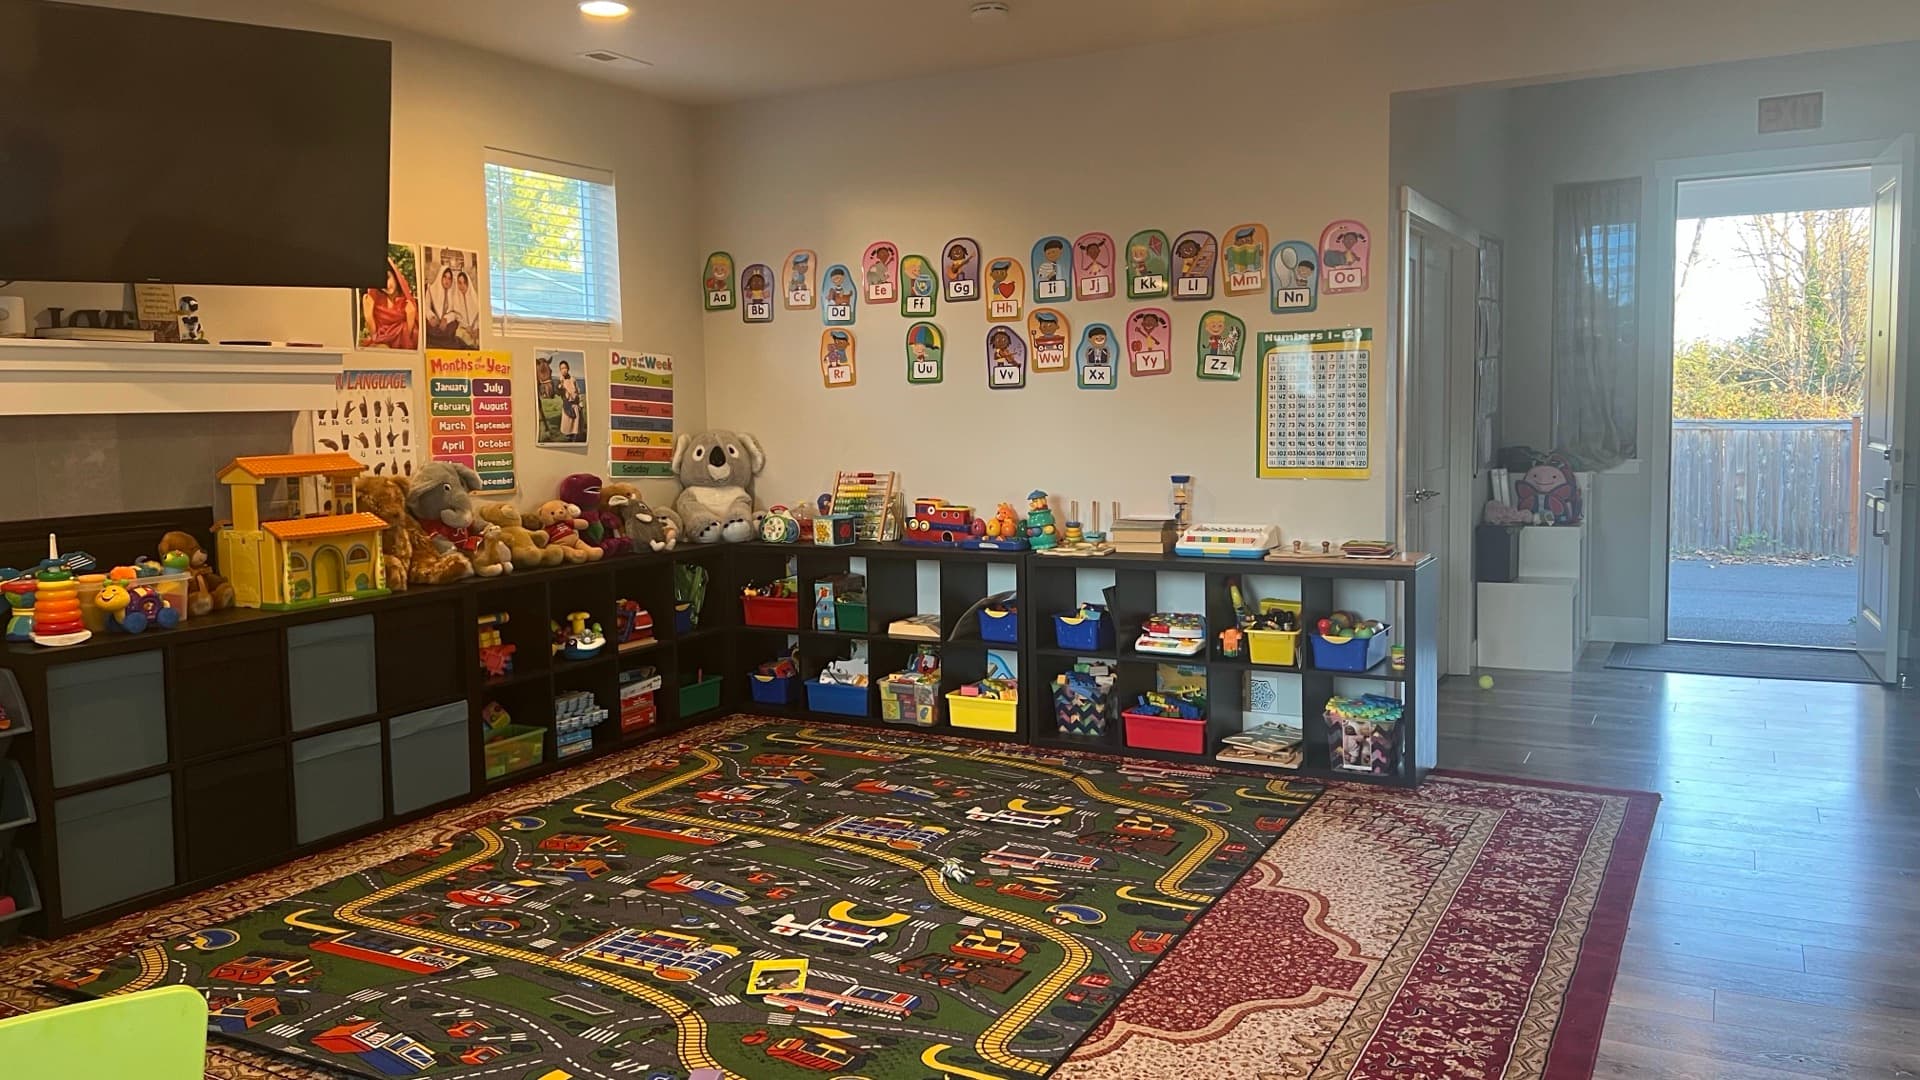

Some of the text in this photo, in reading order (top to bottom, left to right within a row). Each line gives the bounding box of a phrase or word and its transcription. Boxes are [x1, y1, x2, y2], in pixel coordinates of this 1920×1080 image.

[1233, 275, 1258, 287] Mm
[1334, 272, 1355, 283] Oo
[953, 283, 970, 295] Gg
[1048, 283, 1057, 294] Ii
[1089, 278, 1100, 292] Jj
[1140, 278, 1157, 289] Kk
[874, 285, 887, 296] Ee
[713, 293, 727, 302] Aa
[794, 293, 806, 302] Cc
[1284, 291, 1304, 303] Nn
[913, 298, 924, 309] Ff
[996, 302, 1013, 313] Hh
[751, 305, 764, 315] Bb
[831, 307, 846, 317] Dd
[1264, 331, 1323, 342] Numbers
[612, 352, 637, 369] Days
[645, 356, 672, 370] Week
[1038, 353, 1061, 364] Ww
[1142, 355, 1158, 368] Yy
[431, 358, 472, 374] Months
[487, 357, 510, 374] Year
[918, 364, 933, 374] Uu
[1210, 359, 1228, 370] Zz
[624, 373, 648, 384] Sunday
[833, 369, 844, 379] Rr
[1000, 369, 1014, 380] Vv
[1089, 369, 1105, 380] Xx
[347, 374, 406, 390] LANGUAGE
[435, 382, 468, 393] January
[484, 383, 503, 394] July
[434, 402, 470, 412] February
[479, 402, 508, 412] August
[440, 421, 466, 430] March
[475, 422, 511, 432] September
[622, 434, 650, 444] Thursday
[442, 440, 464, 453] April
[478, 459, 512, 468] November
